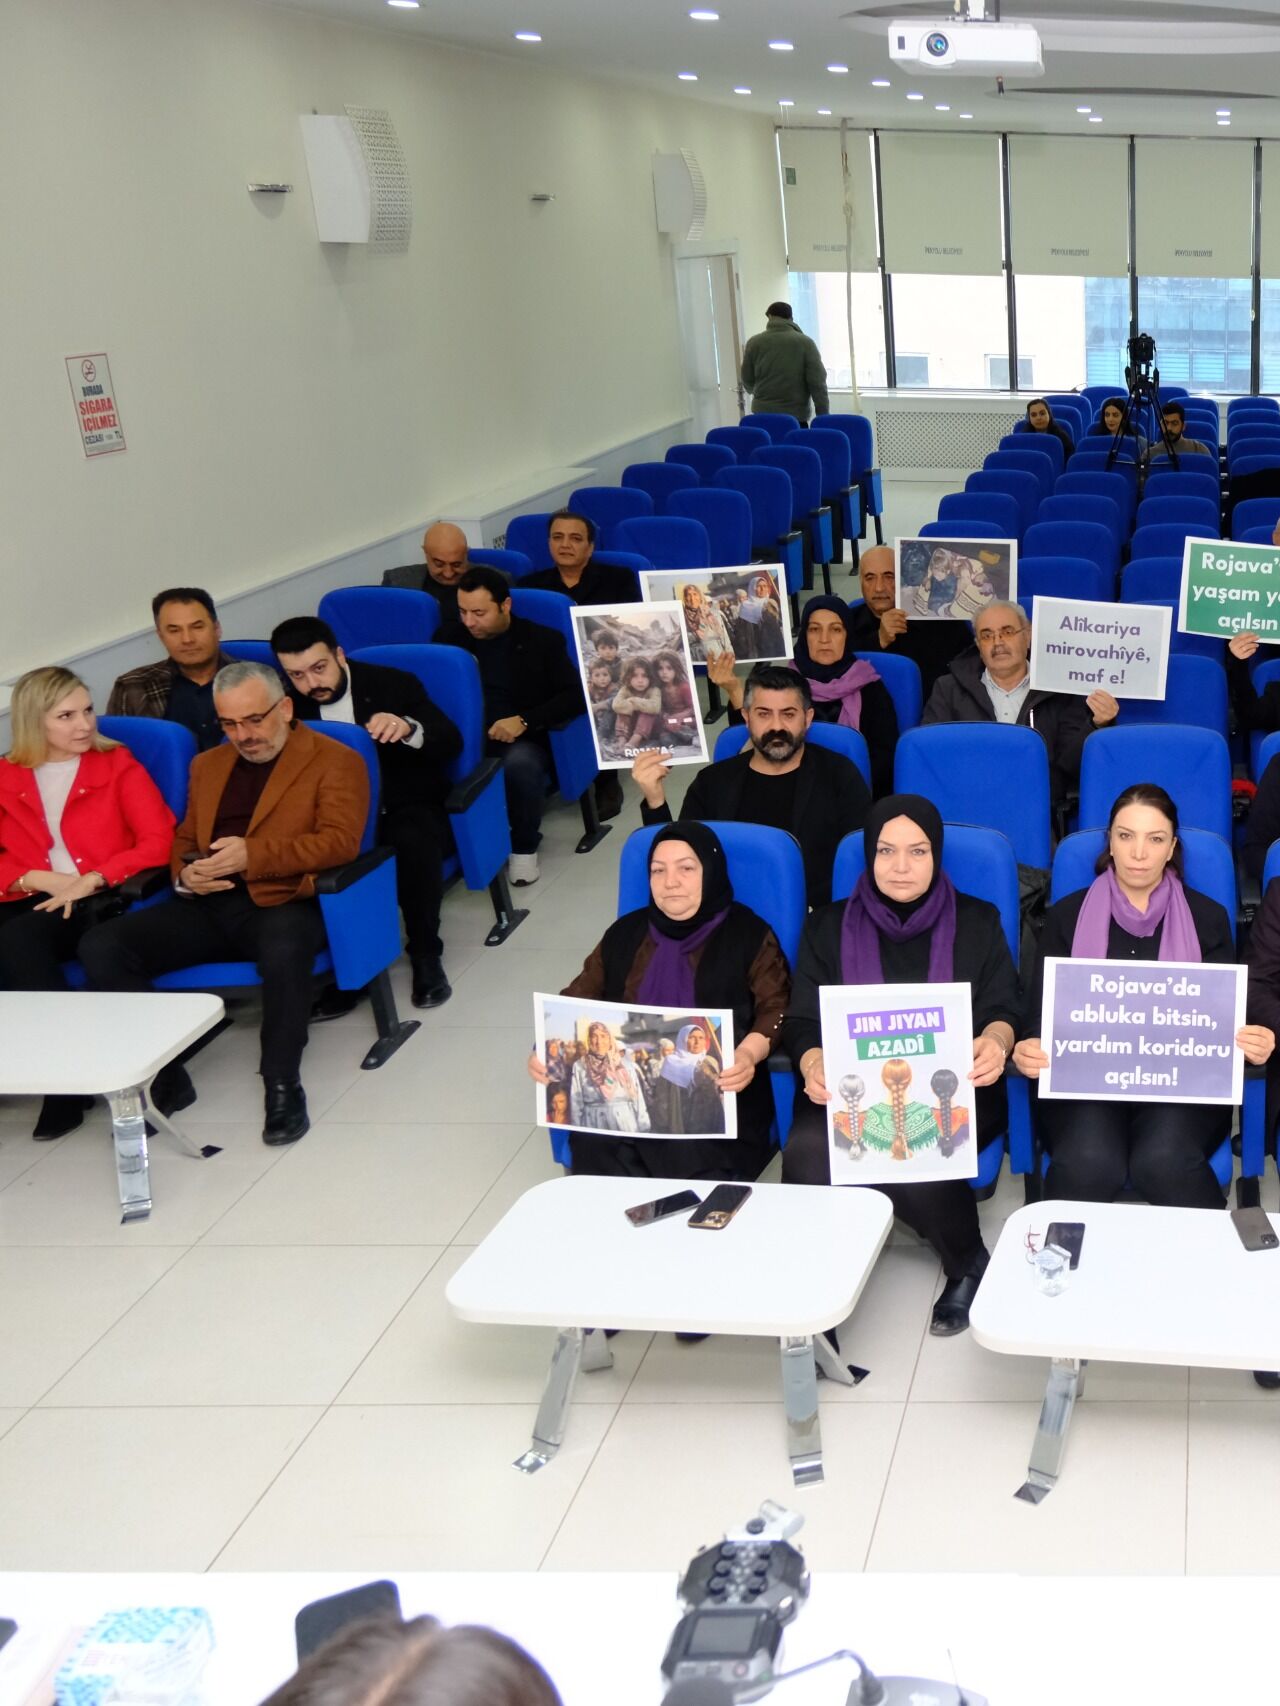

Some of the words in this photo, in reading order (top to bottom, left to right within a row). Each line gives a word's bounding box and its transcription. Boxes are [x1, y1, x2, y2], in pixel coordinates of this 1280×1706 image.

[79, 398, 114, 415] SİGARA
[1192, 584, 1260, 604] yaşam
[1059, 615, 1141, 640] Alîkariya
[1218, 612, 1278, 633] açılsın
[1068, 668, 1104, 684] maf
[1109, 669, 1125, 685] e!
[1090, 973, 1201, 999] Rojava’da
[853, 1015, 883, 1034] JIN
[887, 1011, 940, 1031] JIYAN
[1070, 1003, 1146, 1025] abluka
[1152, 1006, 1218, 1031] bitsin,
[867, 1034, 925, 1058] AZADÎ
[1055, 1034, 1132, 1057] yardım
[1139, 1036, 1231, 1058] koridoru
[1104, 1066, 1178, 1090] açılsın!
